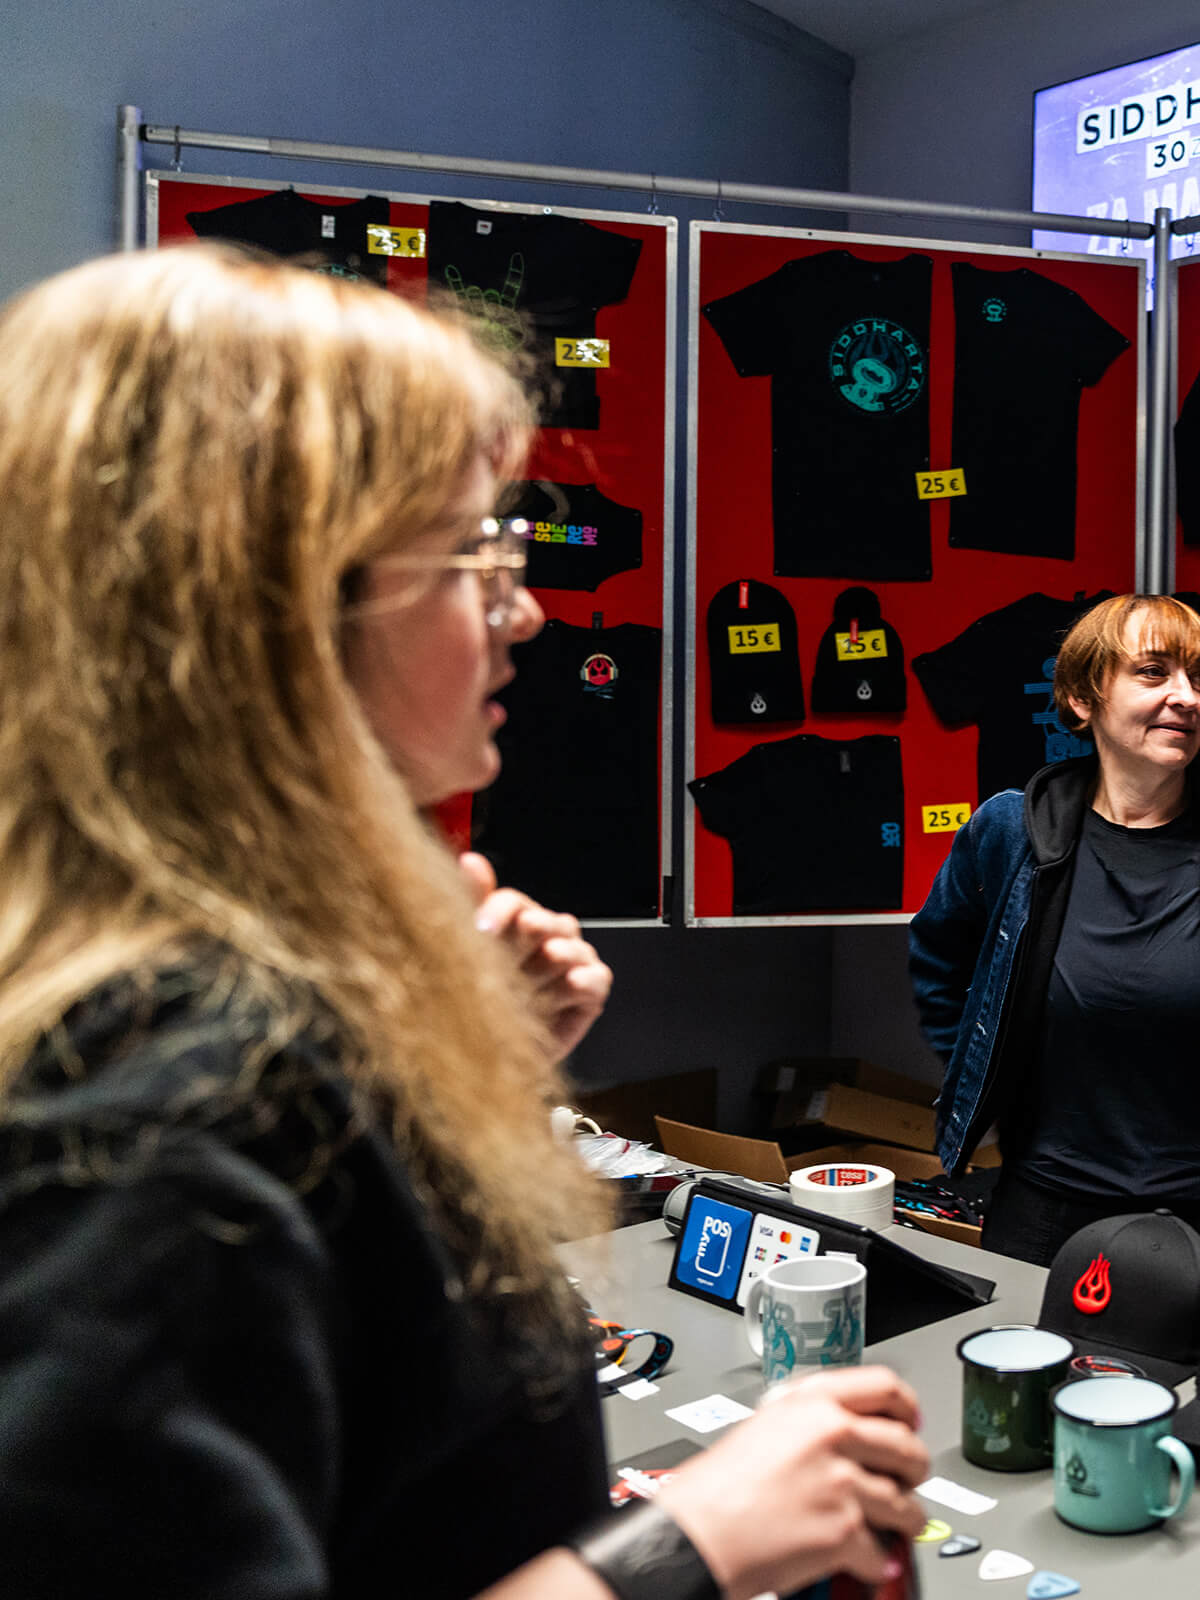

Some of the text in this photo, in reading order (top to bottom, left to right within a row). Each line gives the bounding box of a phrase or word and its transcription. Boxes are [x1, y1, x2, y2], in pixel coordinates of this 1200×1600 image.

[1153, 140, 1185, 168] 30
[832, 320, 923, 391] SIDDHARTA
[922, 477, 945, 494] 25
[735, 629, 759, 648] 15
[843, 637, 867, 654] 15
[927, 810, 951, 828] 25
